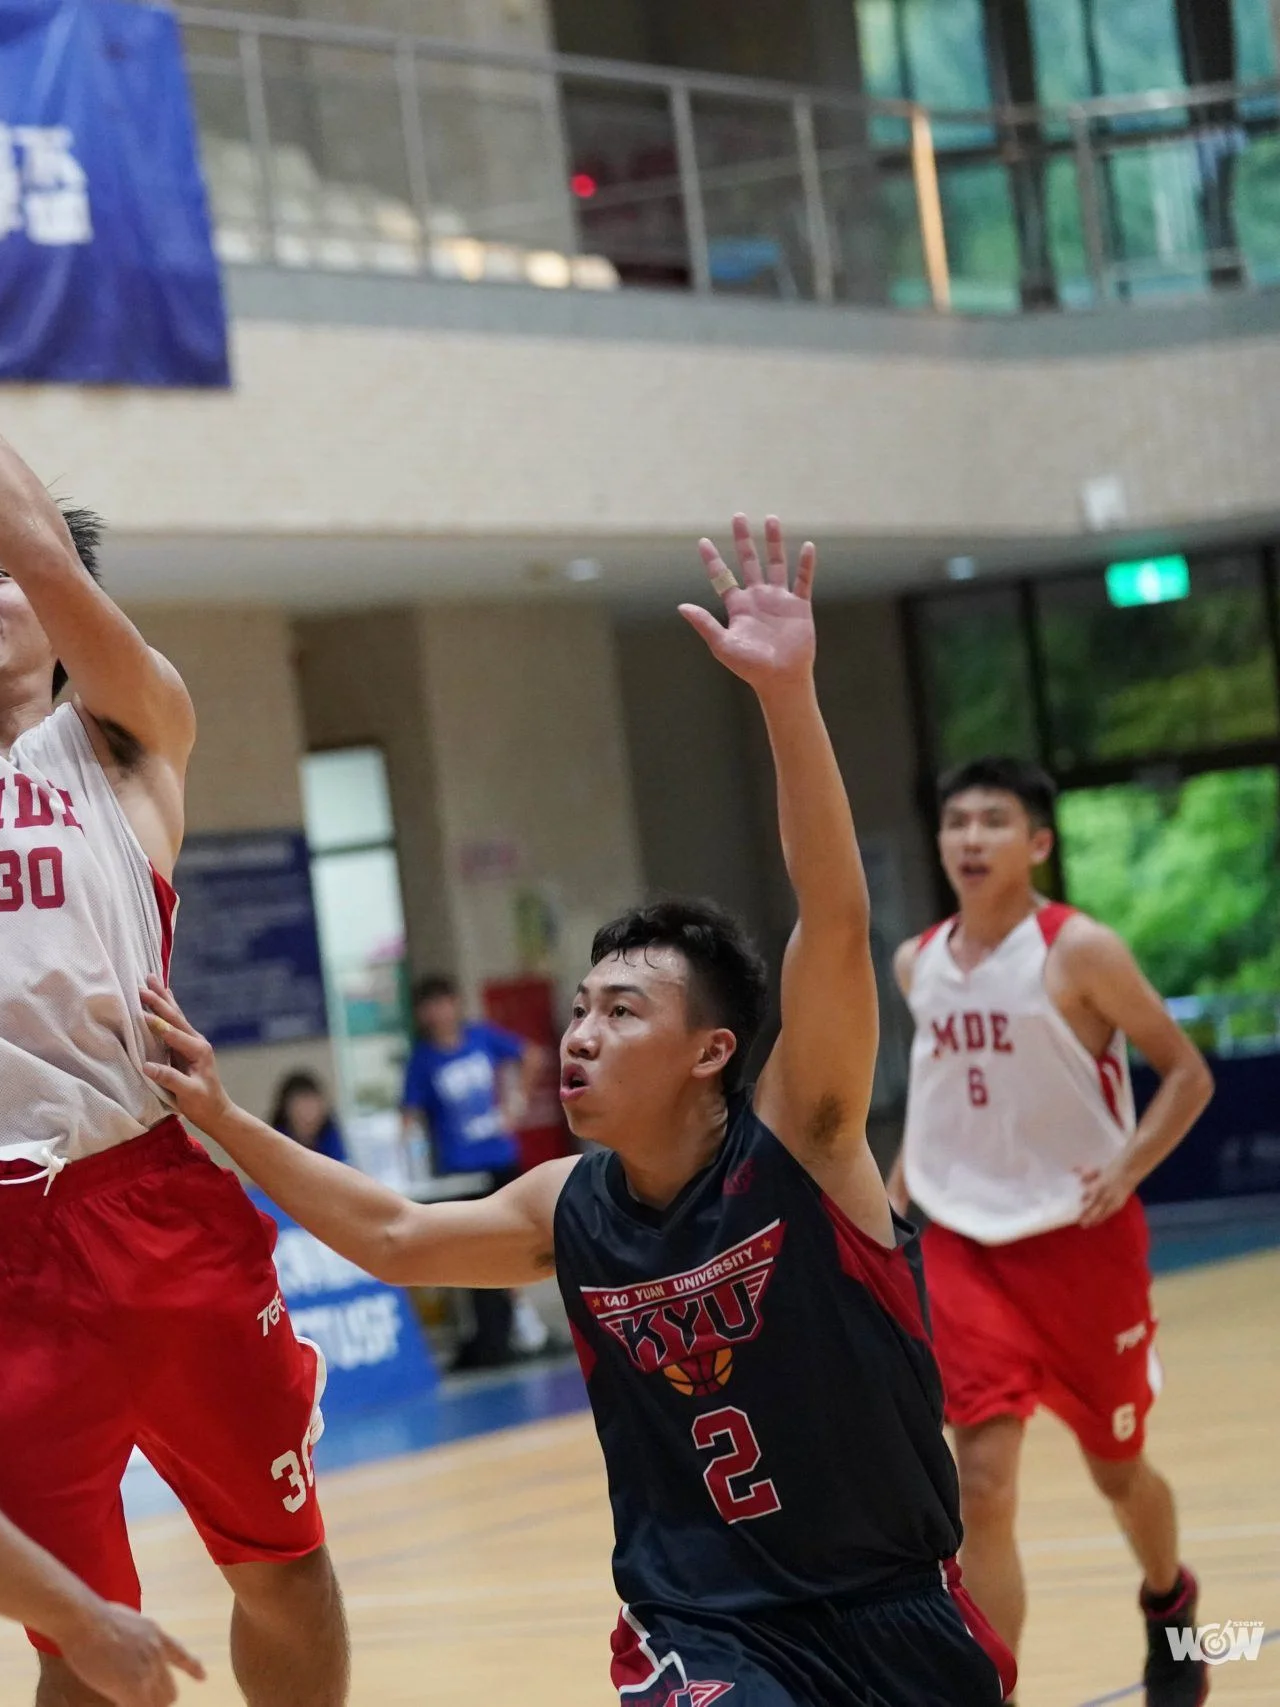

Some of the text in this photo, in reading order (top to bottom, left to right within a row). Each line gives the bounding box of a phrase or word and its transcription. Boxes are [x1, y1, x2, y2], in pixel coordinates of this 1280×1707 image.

[931, 1011, 1015, 1060] MDE
[968, 1066, 989, 1107] 6
[602, 1248, 754, 1307] KAO YUAN UNIVERSITY
[620, 1280, 759, 1372] KYU
[690, 1405, 781, 1525] 2
